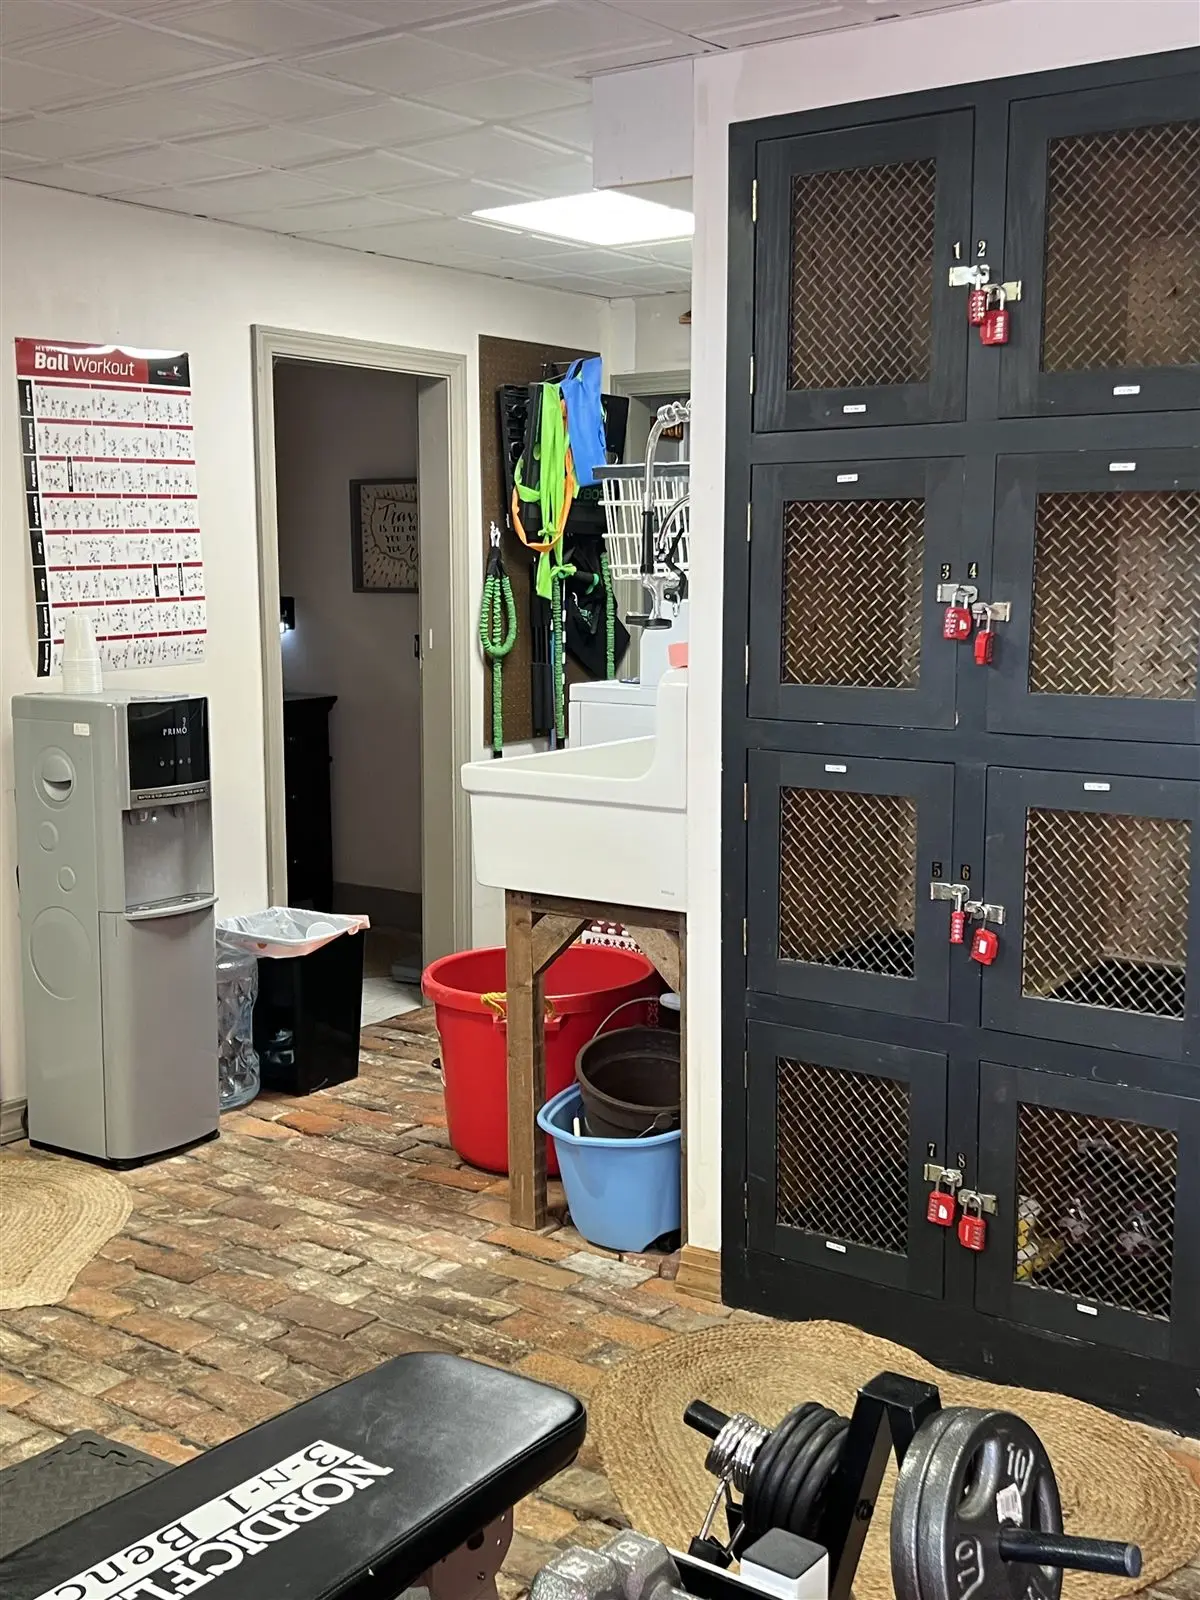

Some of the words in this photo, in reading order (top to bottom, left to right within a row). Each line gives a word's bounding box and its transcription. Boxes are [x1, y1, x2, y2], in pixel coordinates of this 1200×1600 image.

[953, 242, 961, 259] 1
[977, 240, 986, 257] 2
[34, 352, 69, 371] Ball
[72, 356, 135, 376] Workout
[941, 564, 950, 580] 3
[968, 562, 978, 579] 4
[162, 722, 188, 736] PRIMO
[933, 863, 941, 877] 5
[961, 865, 970, 880] 6
[928, 1143, 936, 1157] 7
[957, 1153, 966, 1168] 8
[107, 1455, 394, 1600] NORDICFL
